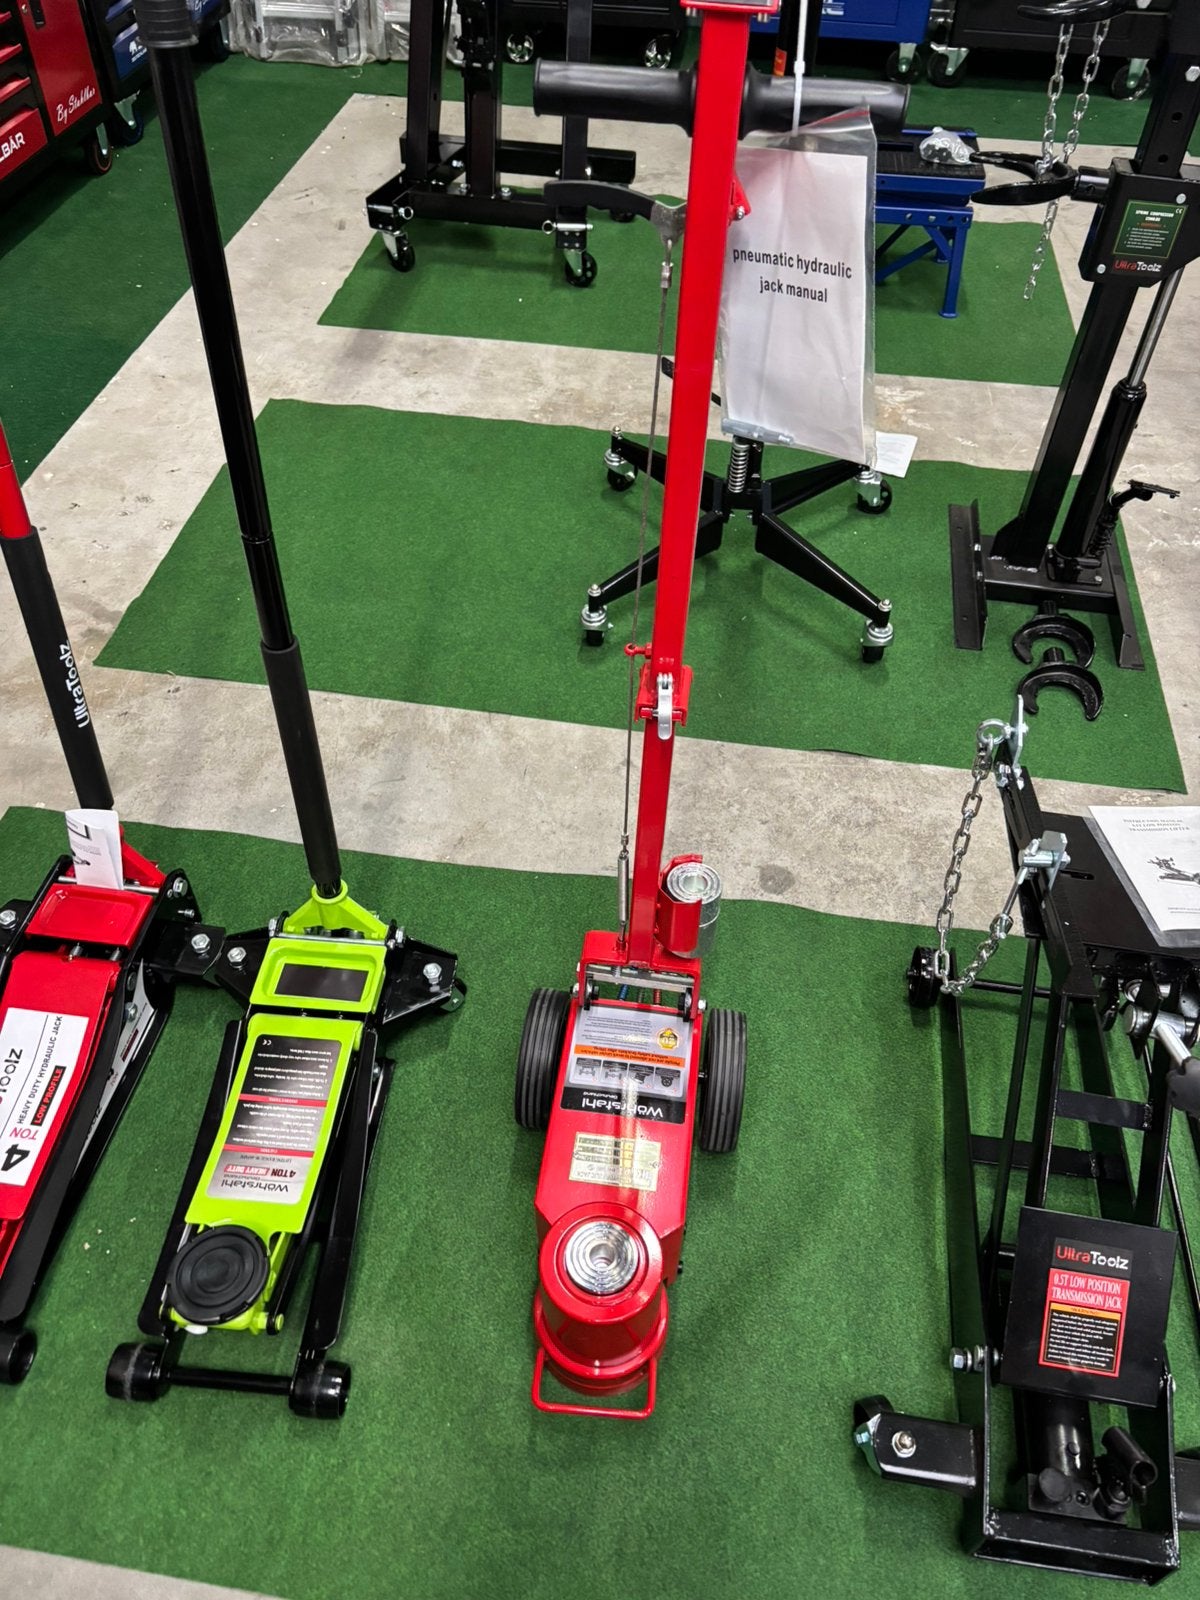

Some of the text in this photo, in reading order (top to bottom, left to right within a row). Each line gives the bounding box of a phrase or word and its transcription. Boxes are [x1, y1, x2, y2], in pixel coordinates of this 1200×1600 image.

[56, 104, 68, 124] By
[733, 249, 852, 278] pneumatic hydraulic
[1114, 260, 1162, 272] UltraToolz
[760, 276, 828, 302] jack manual
[60, 641, 90, 728] UltraToolz
[18, 1016, 62, 1124] HEAVY DUTY HYDRAULIC JACK
[35, 1068, 62, 1124] LOW PROFILE
[582, 1098, 663, 1118] Wöhrstahl
[0, 1127, 38, 1171] 4 TON
[244, 1166, 268, 1175] HEAVY
[271, 1168, 288, 1178] TON
[289, 1170, 296, 1178] 4
[221, 1179, 288, 1192] Wöhrstahl
[1056, 1246, 1128, 1270] UltraToolz
[1070, 1276, 1087, 1289] LOW
[1088, 1278, 1120, 1294] POSITION
[1052, 1287, 1122, 1309] TRANSMISSION JACK
